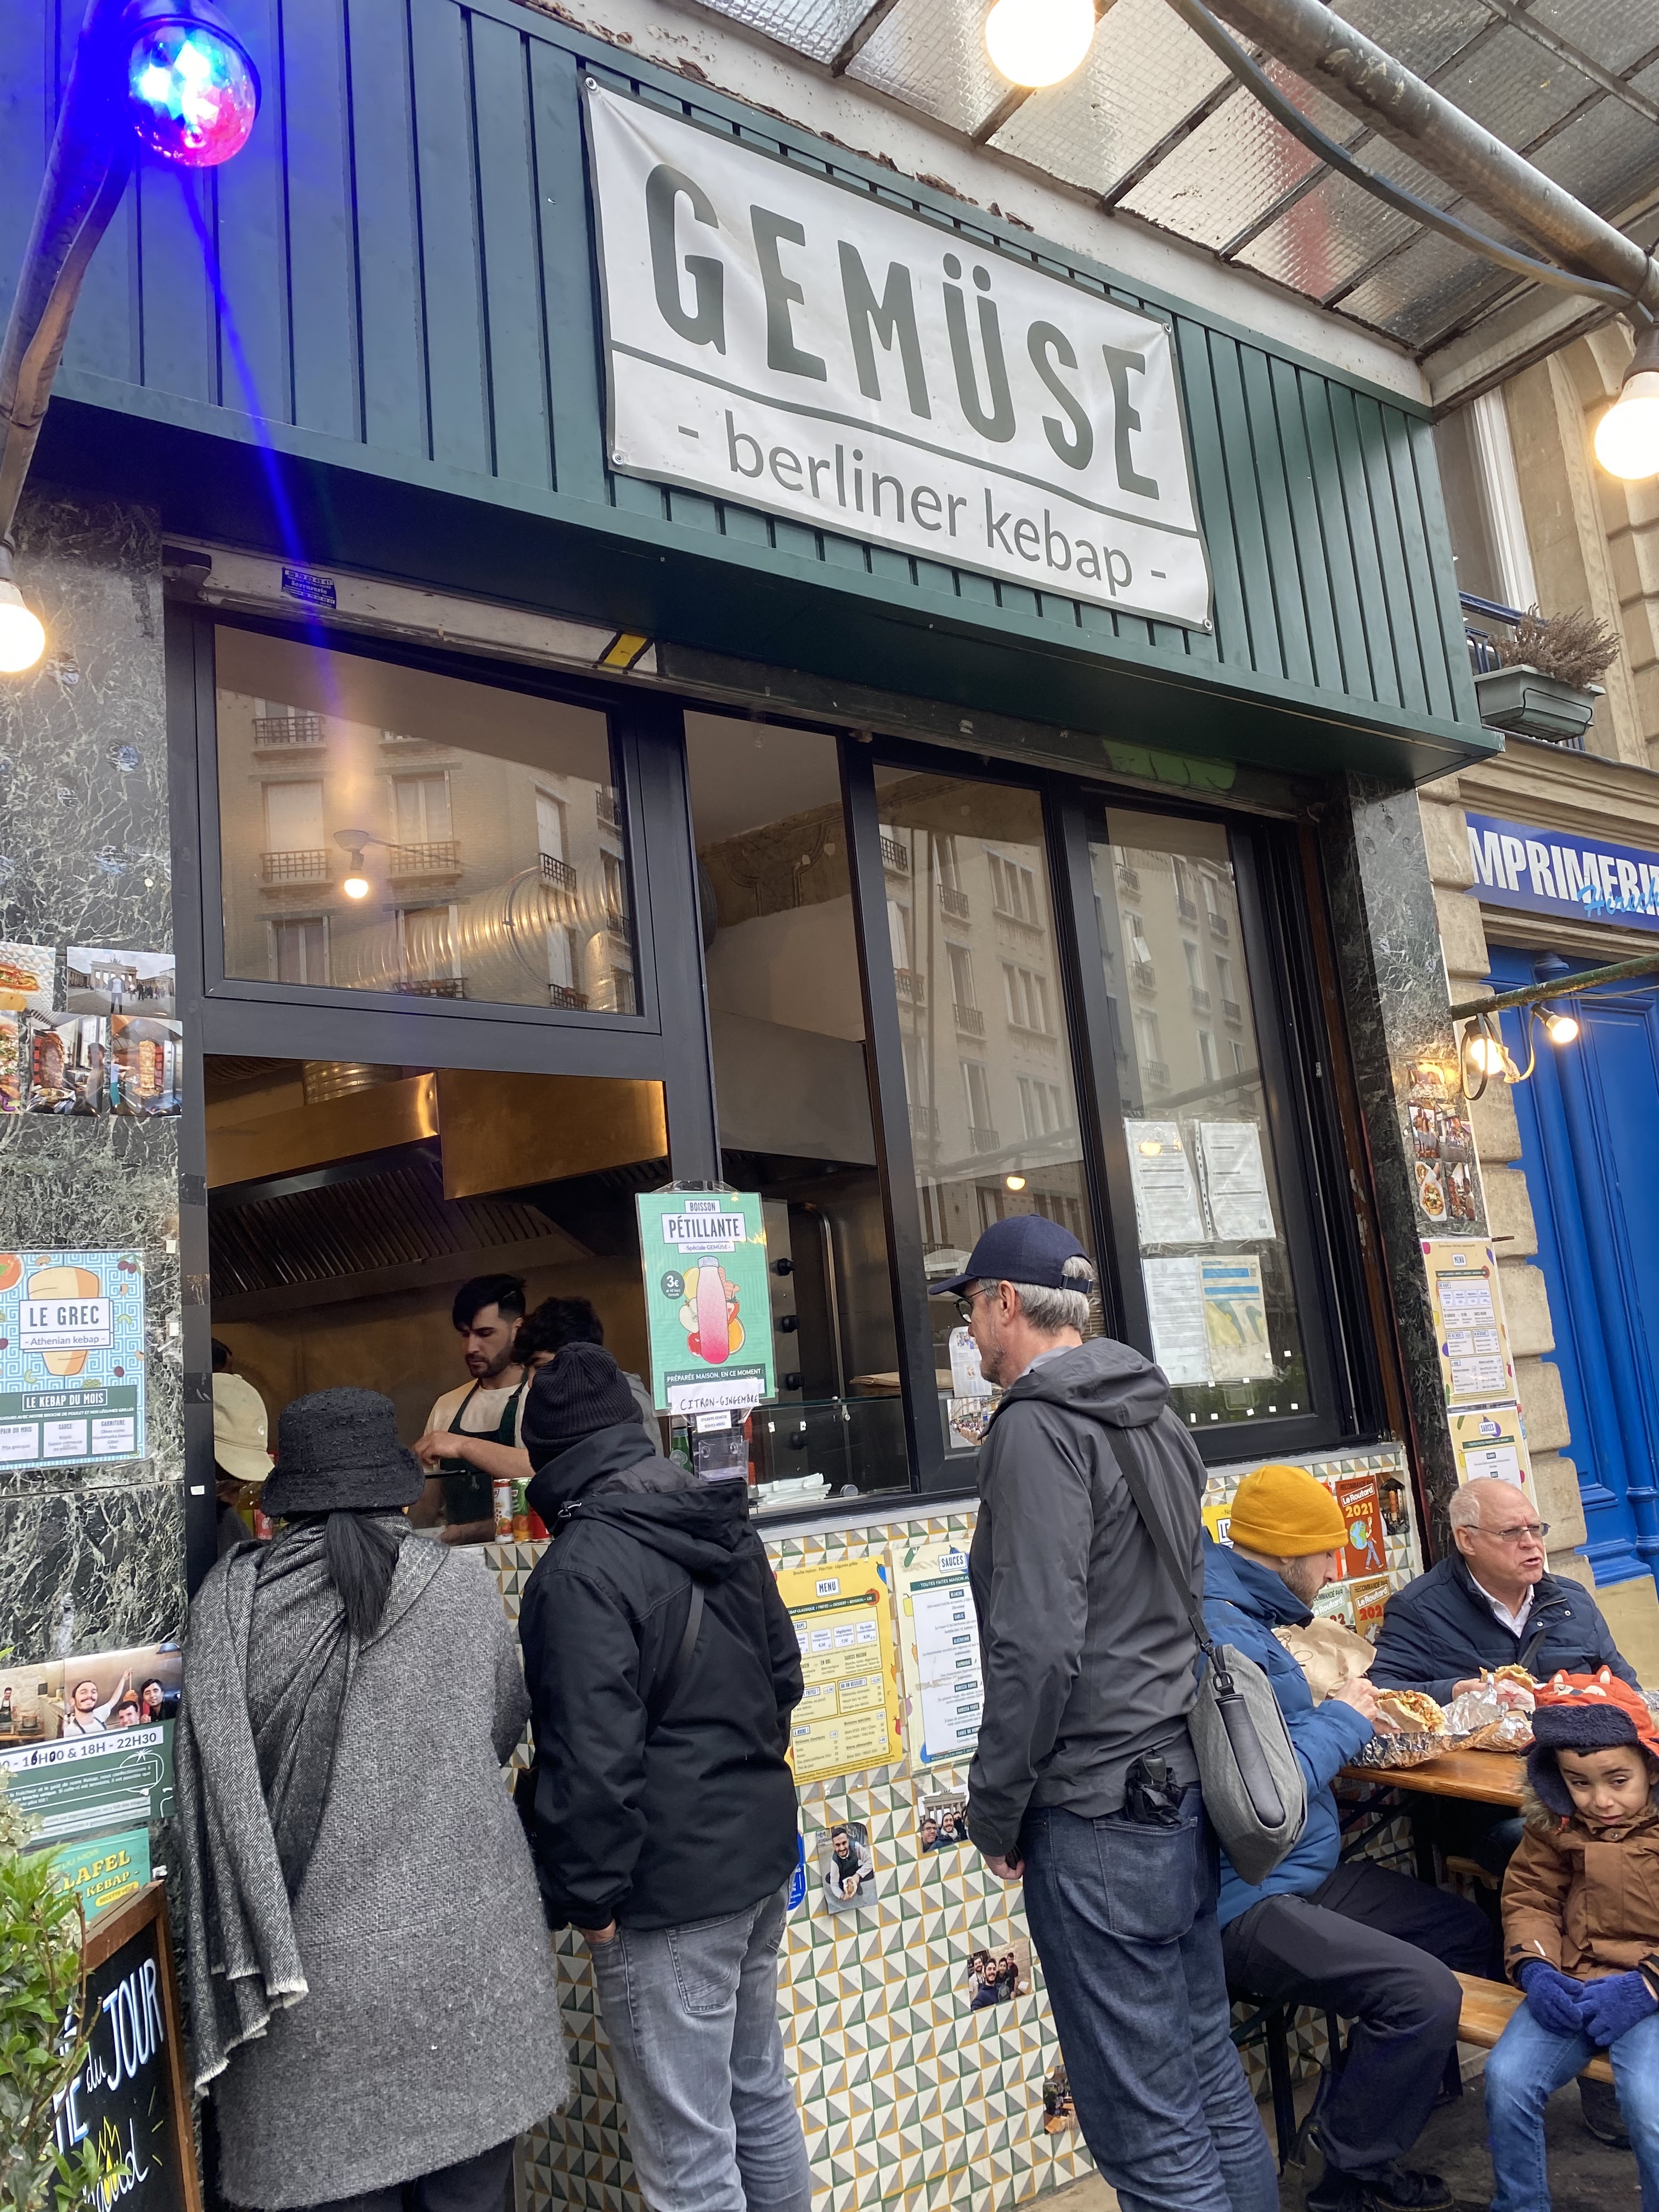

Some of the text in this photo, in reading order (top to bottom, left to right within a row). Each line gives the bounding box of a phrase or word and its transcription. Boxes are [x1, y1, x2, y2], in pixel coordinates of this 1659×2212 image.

[646, 163, 1160, 500] GEMÜSE
[725, 410, 1133, 596] berliner kebap
[291, 580, 327, 594] Serrurerie
[690, 1202, 715, 1211] BOISSON
[669, 1215, 740, 1238] PÉTILLANTE
[667, 1275, 679, 1288] 3€
[30, 1305, 99, 1327] LE GREC
[31, 1336, 99, 1346] Athenian kebap
[667, 1373, 694, 1383] PRÉPARÉE
[26, 1392, 104, 1409] LE KEBAP DU MOIS
[680, 1394, 758, 1410] CITRON-GINGEMBRE
[1481, 1424, 1494, 1432] SAUCES
[1346, 1502, 1373, 1518] 2021
[941, 1555, 963, 1567] SAUCES
[819, 1581, 836, 1593] MENU
[1313, 1589, 1335, 1601] COMMANDÉ
[1354, 1581, 1380, 1593] RECOMMANDÉ
[1319, 1596, 1343, 1613] Routard
[1359, 1604, 1385, 1621] 202
[68, 1748, 77, 1758] &
[81, 1742, 105, 1756] 18H
[117, 1733, 156, 1749] 22H30
[53, 1850, 131, 1894] LAFEL
[86, 1871, 130, 1898] KEBAP
[103, 1958, 164, 2091] JOUR
